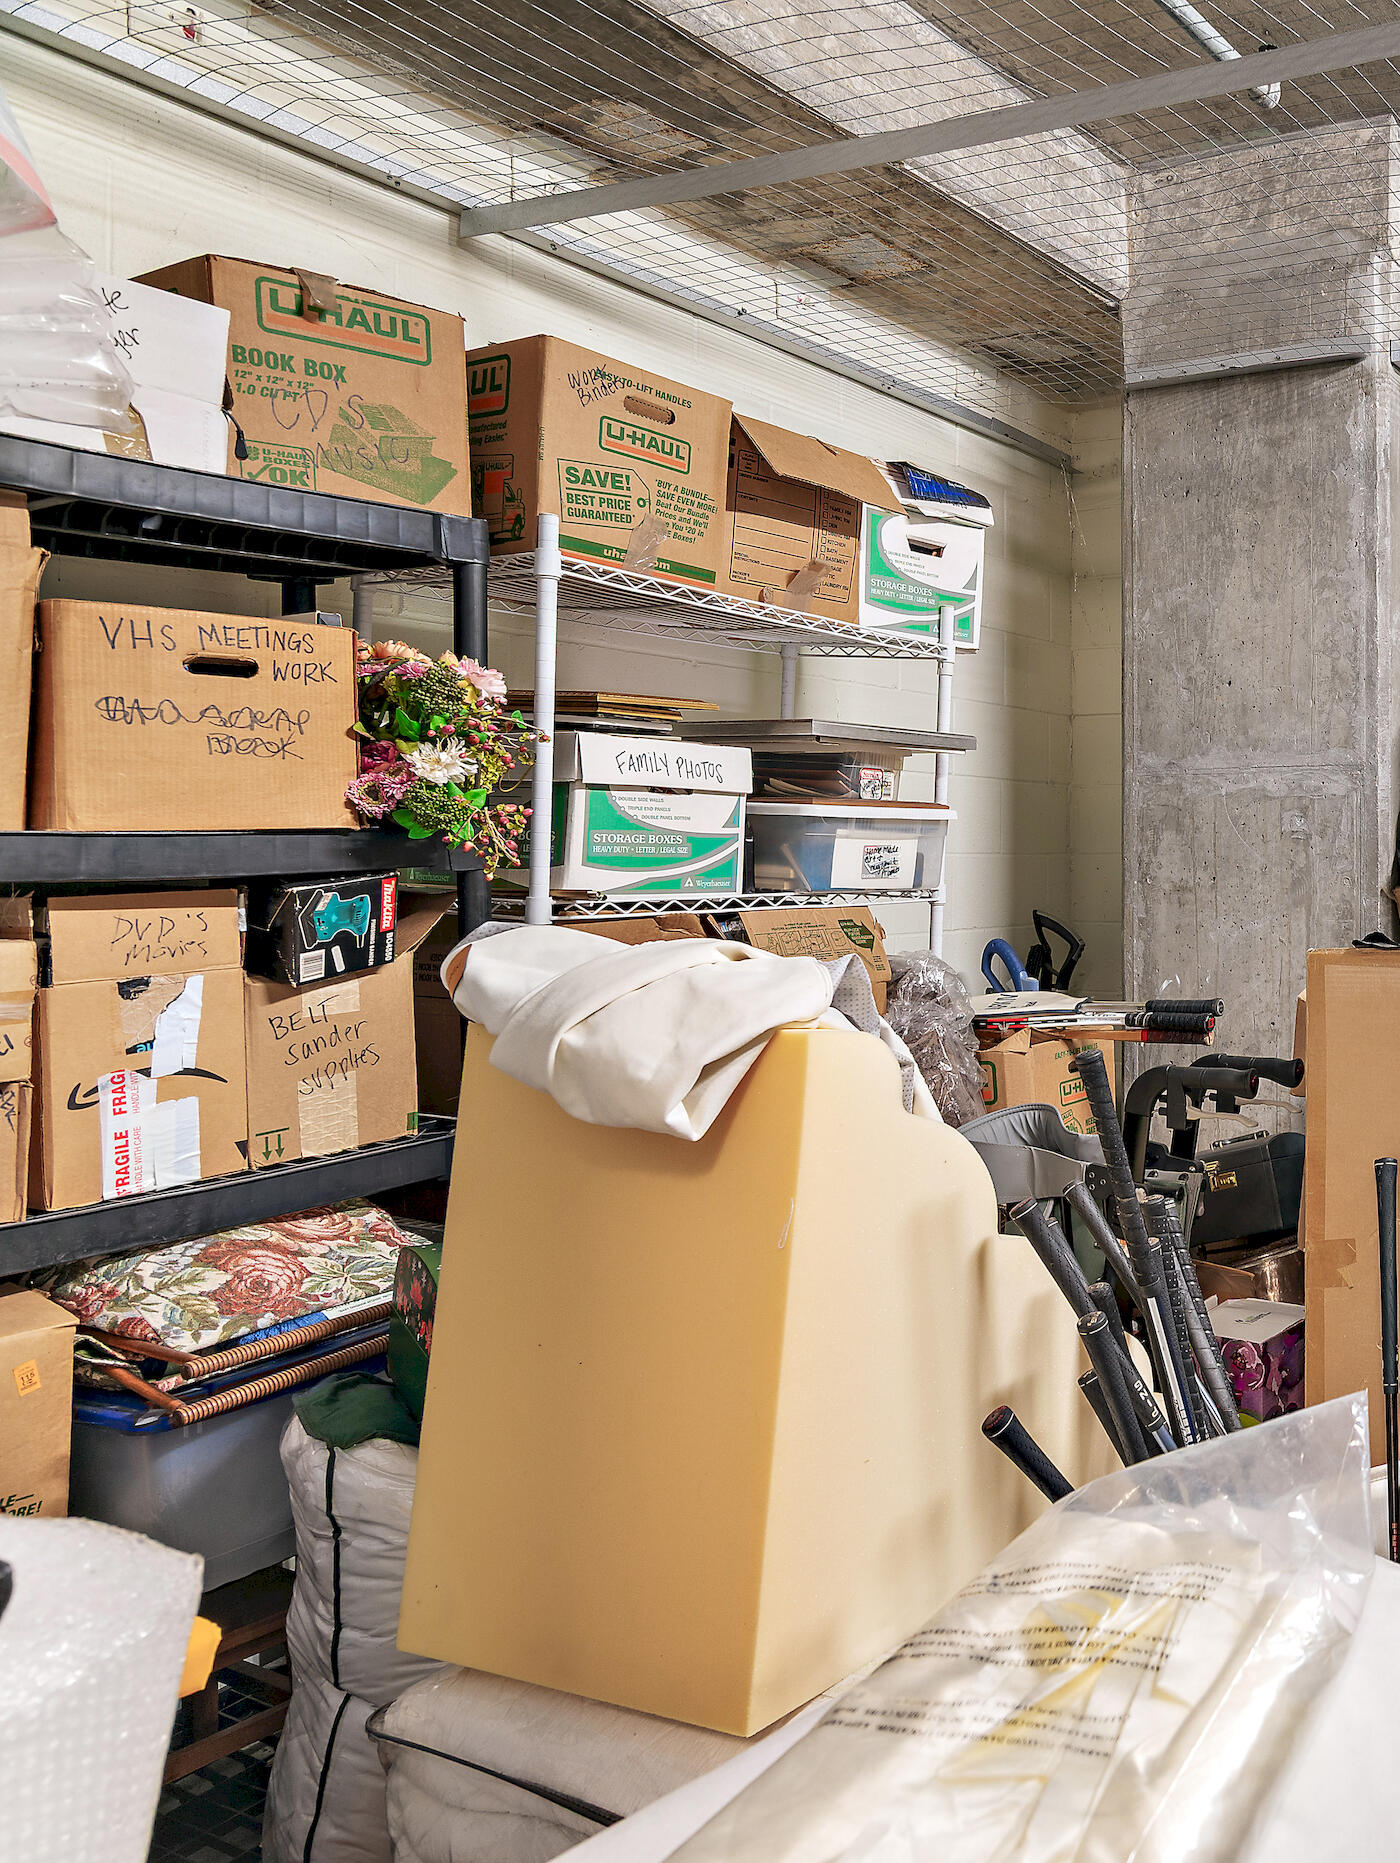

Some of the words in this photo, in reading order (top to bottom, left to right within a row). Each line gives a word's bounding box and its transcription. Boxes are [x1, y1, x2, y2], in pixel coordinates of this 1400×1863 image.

[232, 344, 296, 374] BOOK
[303, 358, 348, 384] BOX
[234, 369, 253, 380] 12"
[266, 374, 284, 385] 12"
[235, 383, 255, 395] 1.0
[655, 389, 692, 409] HANDLES
[607, 423, 686, 461] U-HAUL
[262, 448, 308, 461] U-HAUL
[263, 455, 311, 469] BOXES
[268, 469, 310, 487] OK
[565, 466, 631, 491] SAVE!
[566, 493, 596, 507] BEST
[599, 497, 631, 511] PRICE
[656, 490, 675, 501] SAVE
[676, 495, 695, 506] EVEN
[696, 502, 718, 514] MORE!
[656, 499, 671, 510] Beat
[674, 505, 685, 514] Our
[686, 508, 710, 520] Bundle
[655, 509, 677, 521] Prices
[678, 515, 691, 525] and
[671, 523, 684, 532] You
[697, 529, 705, 537] in
[672, 533, 696, 544] Boxes!
[825, 555, 849, 565] BASEMENT
[870, 578, 907, 592] STORAGE
[908, 585, 933, 597] BOXES
[99, 615, 177, 652] VHS
[198, 623, 315, 654] MEETINGS
[273, 659, 338, 685] WORK
[675, 756, 724, 784] PHOTOS
[593, 834, 645, 844] STORAGE
[647, 834, 683, 845] BOXES
[592, 845, 613, 853] HEAVY
[635, 846, 655, 854] LETTER
[660, 846, 676, 854] LEGAL
[268, 994, 340, 1040] BELT
[110, 1069, 127, 1116] FRAGI
[131, 1085, 140, 1114] HANDLE
[132, 1126, 142, 1146] CARE
[133, 1147, 142, 1165] WITH
[1134, 1380, 1159, 1418] PING
